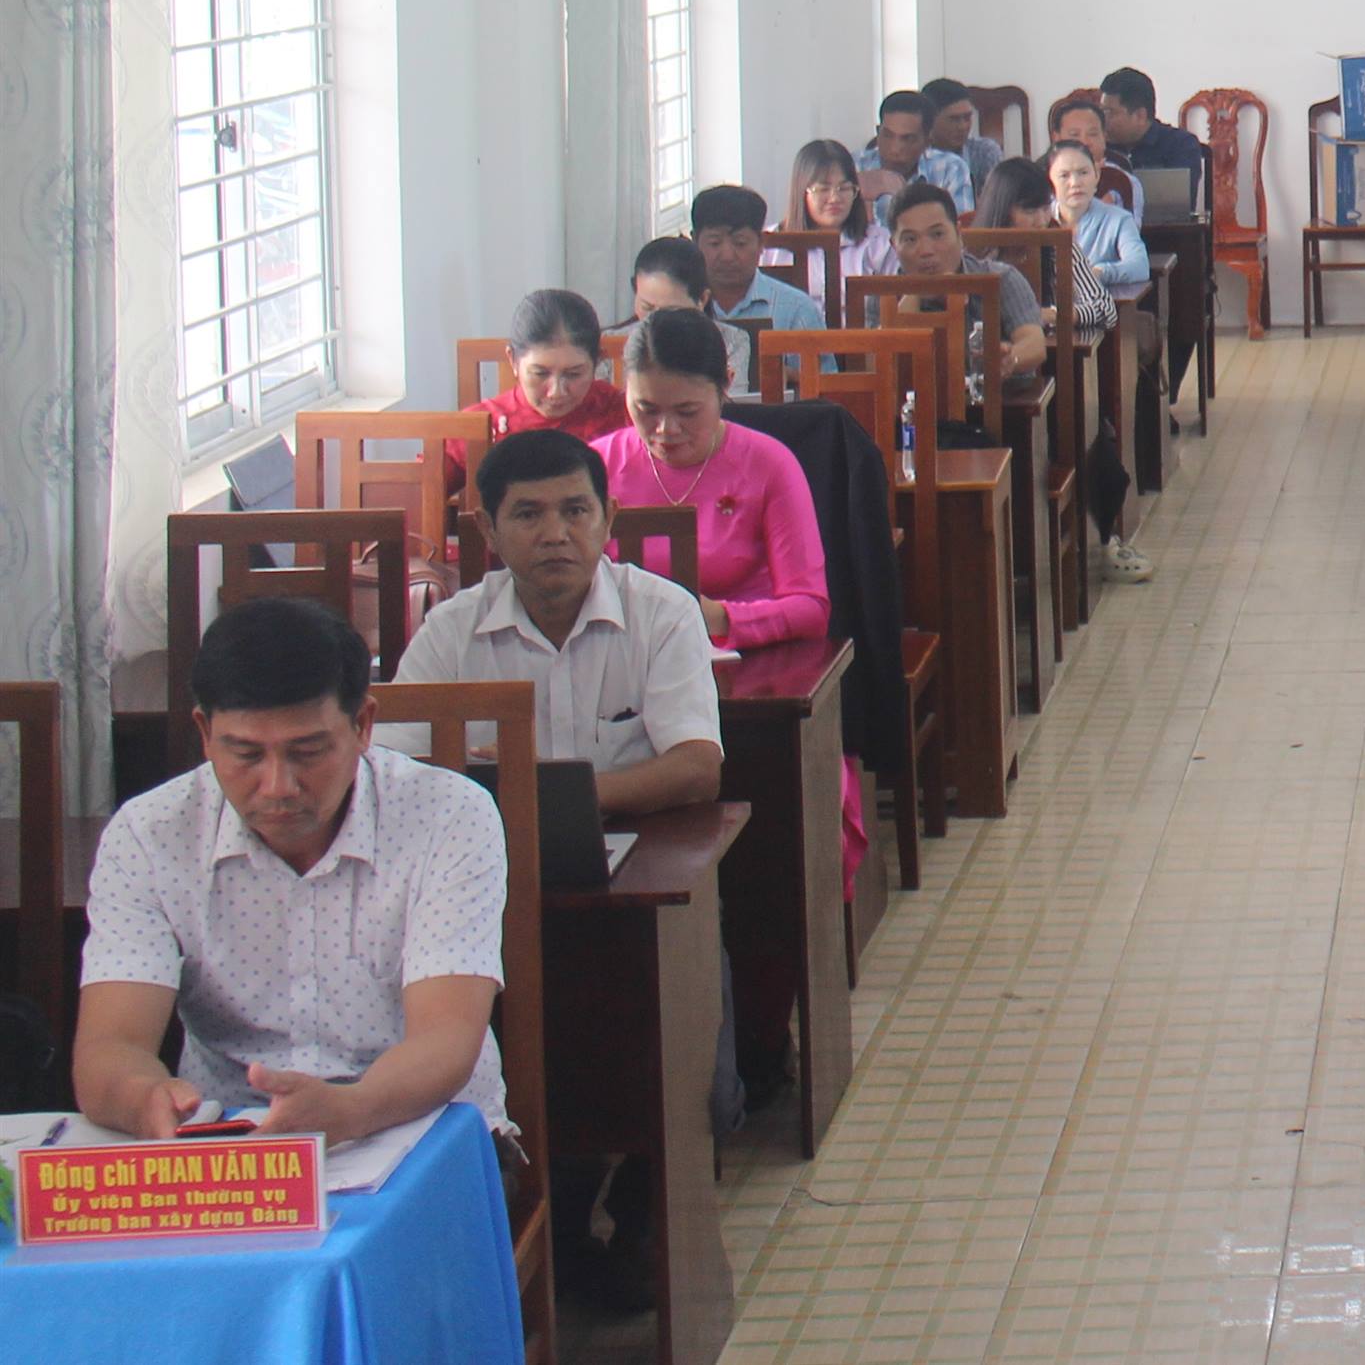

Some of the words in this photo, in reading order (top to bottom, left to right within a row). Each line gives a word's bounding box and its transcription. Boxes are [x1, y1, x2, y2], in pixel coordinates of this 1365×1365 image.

[39, 1158, 96, 1191] Đồng
[103, 1158, 137, 1187] chí
[144, 1156, 203, 1185] PHAN
[210, 1150, 257, 1182] VĂN
[264, 1152, 302, 1180] KIA
[89, 1194, 133, 1210] viên
[141, 1192, 177, 1207] Ban
[186, 1189, 255, 1205] thường
[262, 1189, 286, 1204] vụ
[118, 1214, 151, 1230] ban
[159, 1211, 192, 1228] xây
[200, 1210, 245, 1227] dựng
